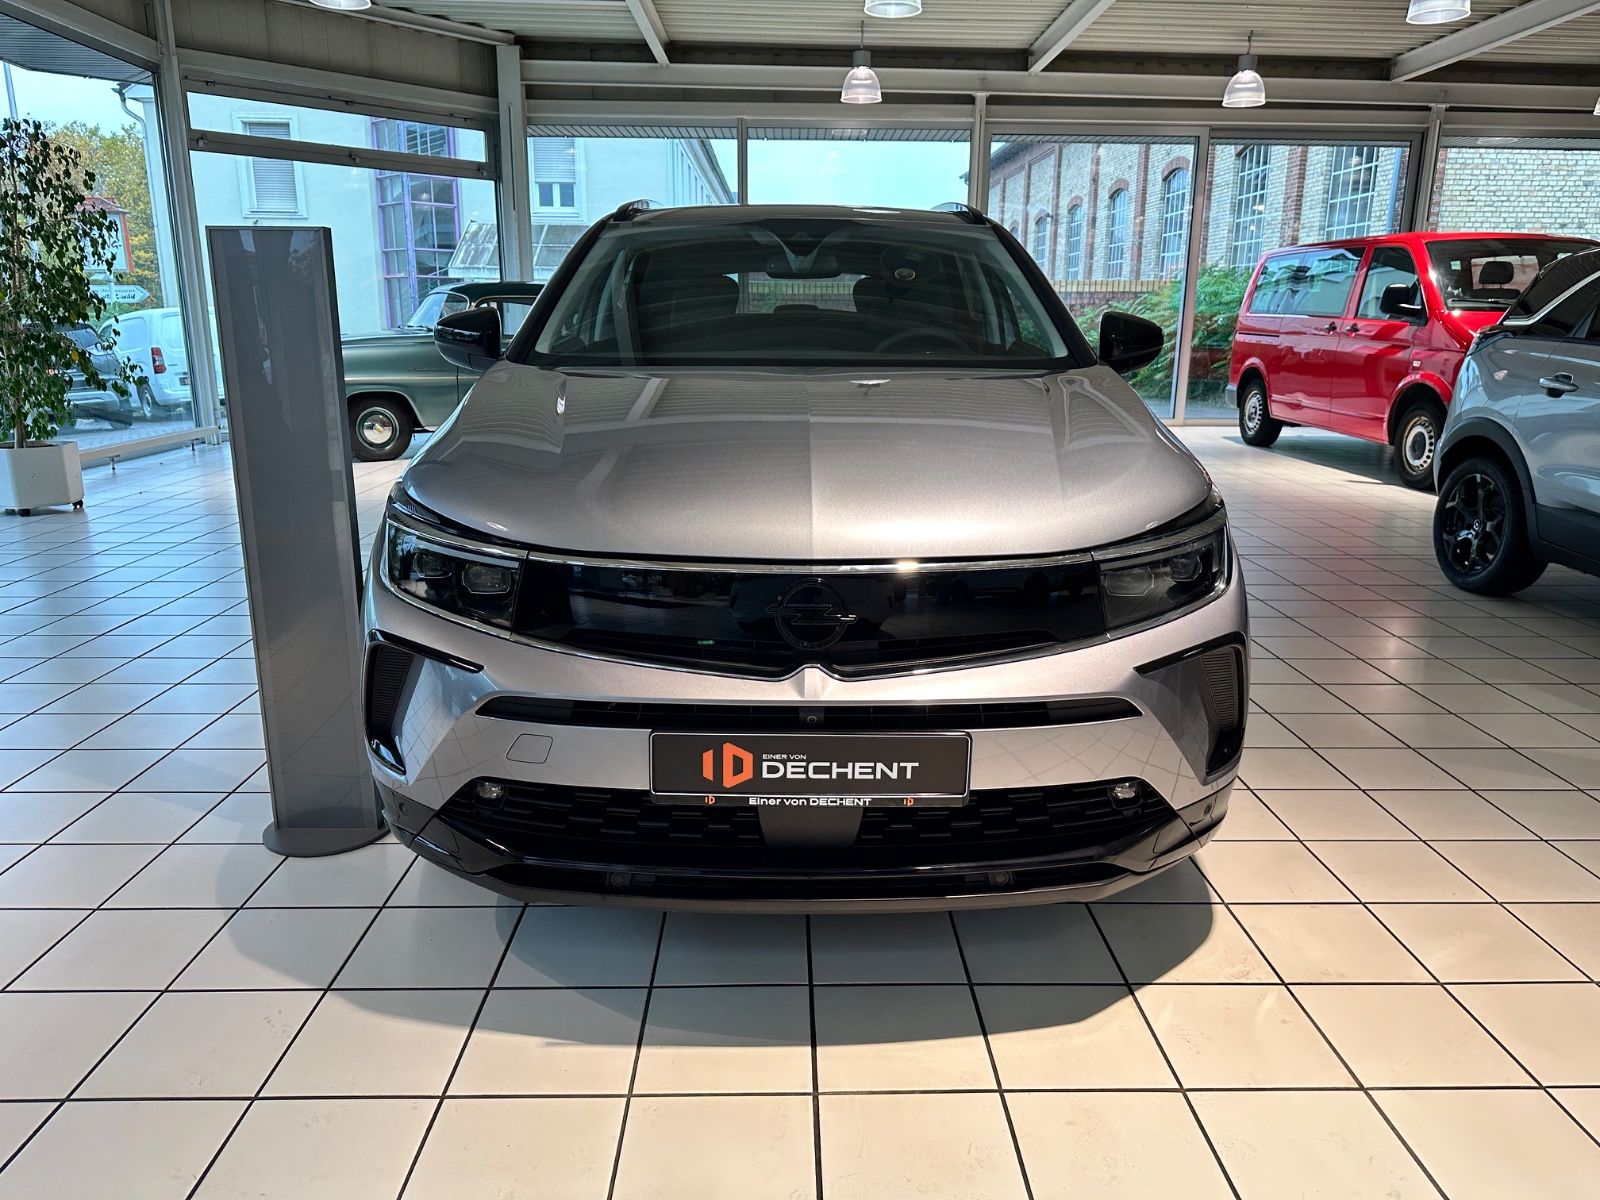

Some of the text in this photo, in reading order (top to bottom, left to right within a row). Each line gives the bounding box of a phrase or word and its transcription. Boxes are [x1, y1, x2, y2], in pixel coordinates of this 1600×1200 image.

[762, 762, 919, 779] DECHENT
[749, 796, 872, 807] Einer von DECHENT
